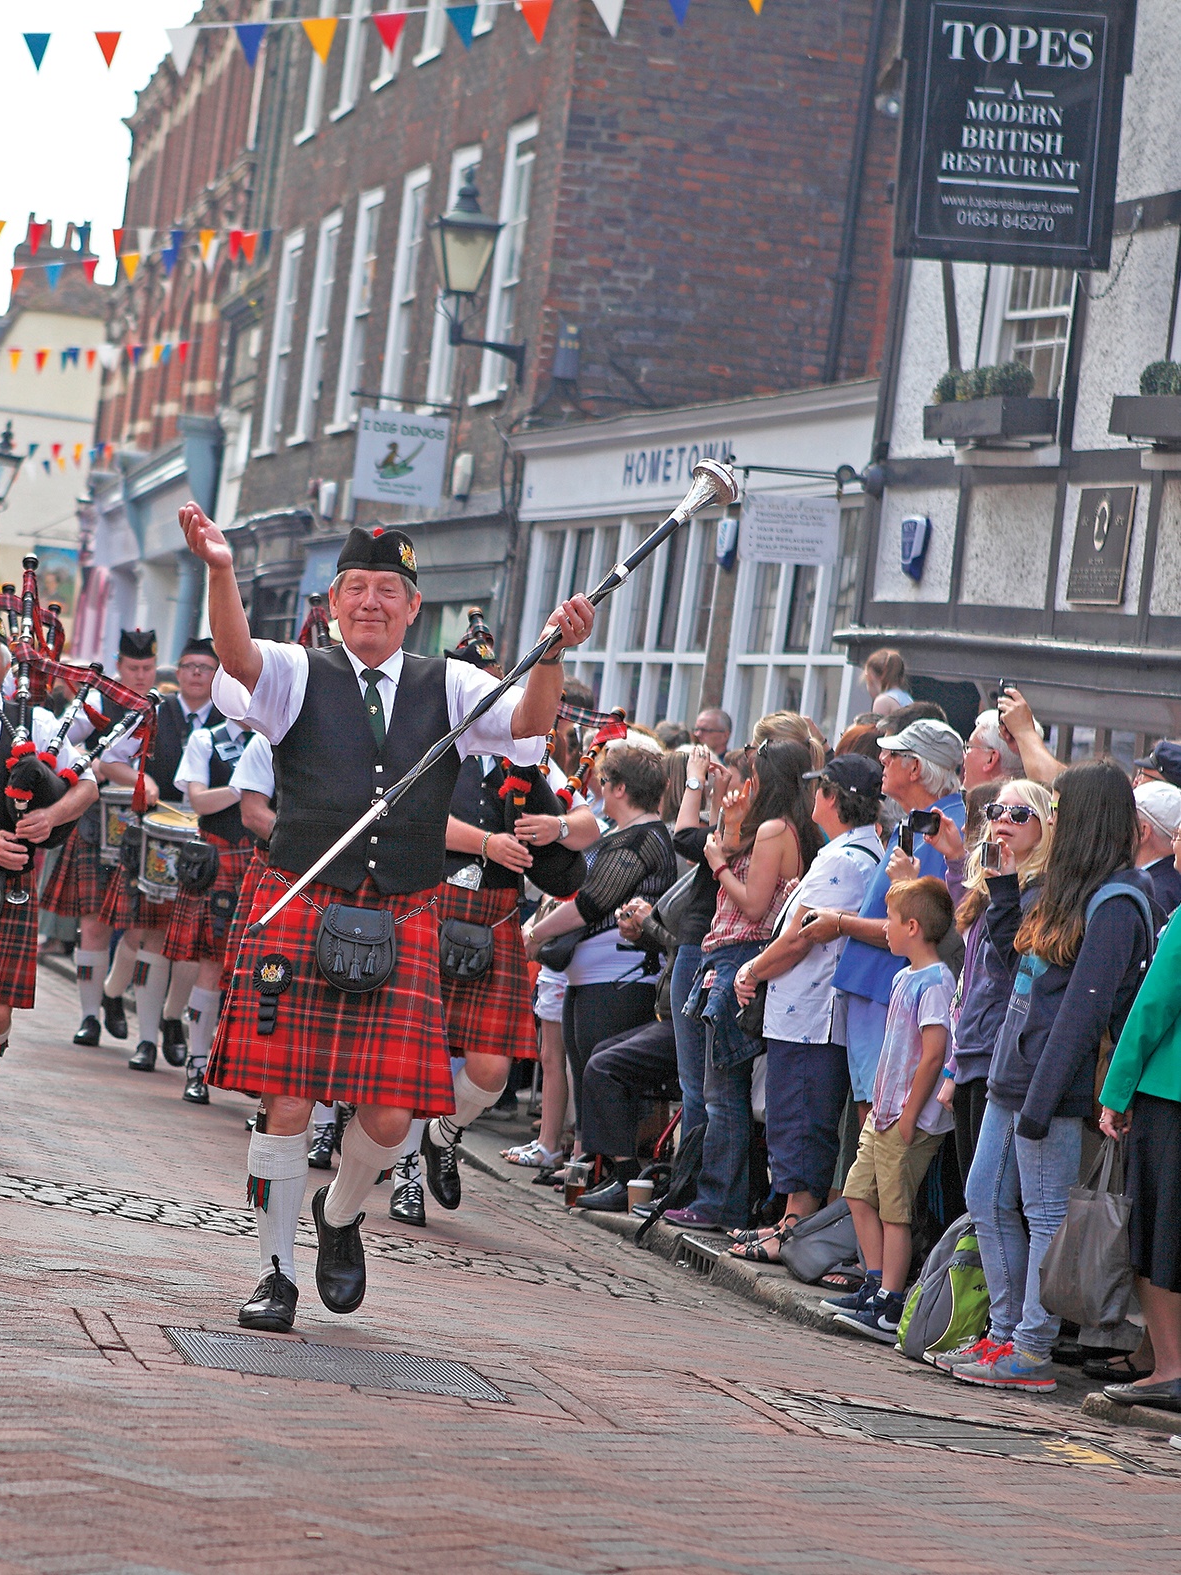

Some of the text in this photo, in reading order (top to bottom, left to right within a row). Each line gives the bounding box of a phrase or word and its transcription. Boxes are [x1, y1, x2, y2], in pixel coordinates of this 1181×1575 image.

[941, 19, 1095, 71] TOPES
[1007, 77, 1025, 101] A
[966, 98, 1064, 127] MODERN
[961, 124, 1065, 156] BRITISH
[941, 150, 1081, 181] RESTAURANT
[941, 193, 1075, 216] www.topesrestaurant.com
[956, 208, 1056, 233] 01634 845270
[363, 419, 446, 441] I DIG DINOS
[622, 439, 734, 487] HOMETOWN
